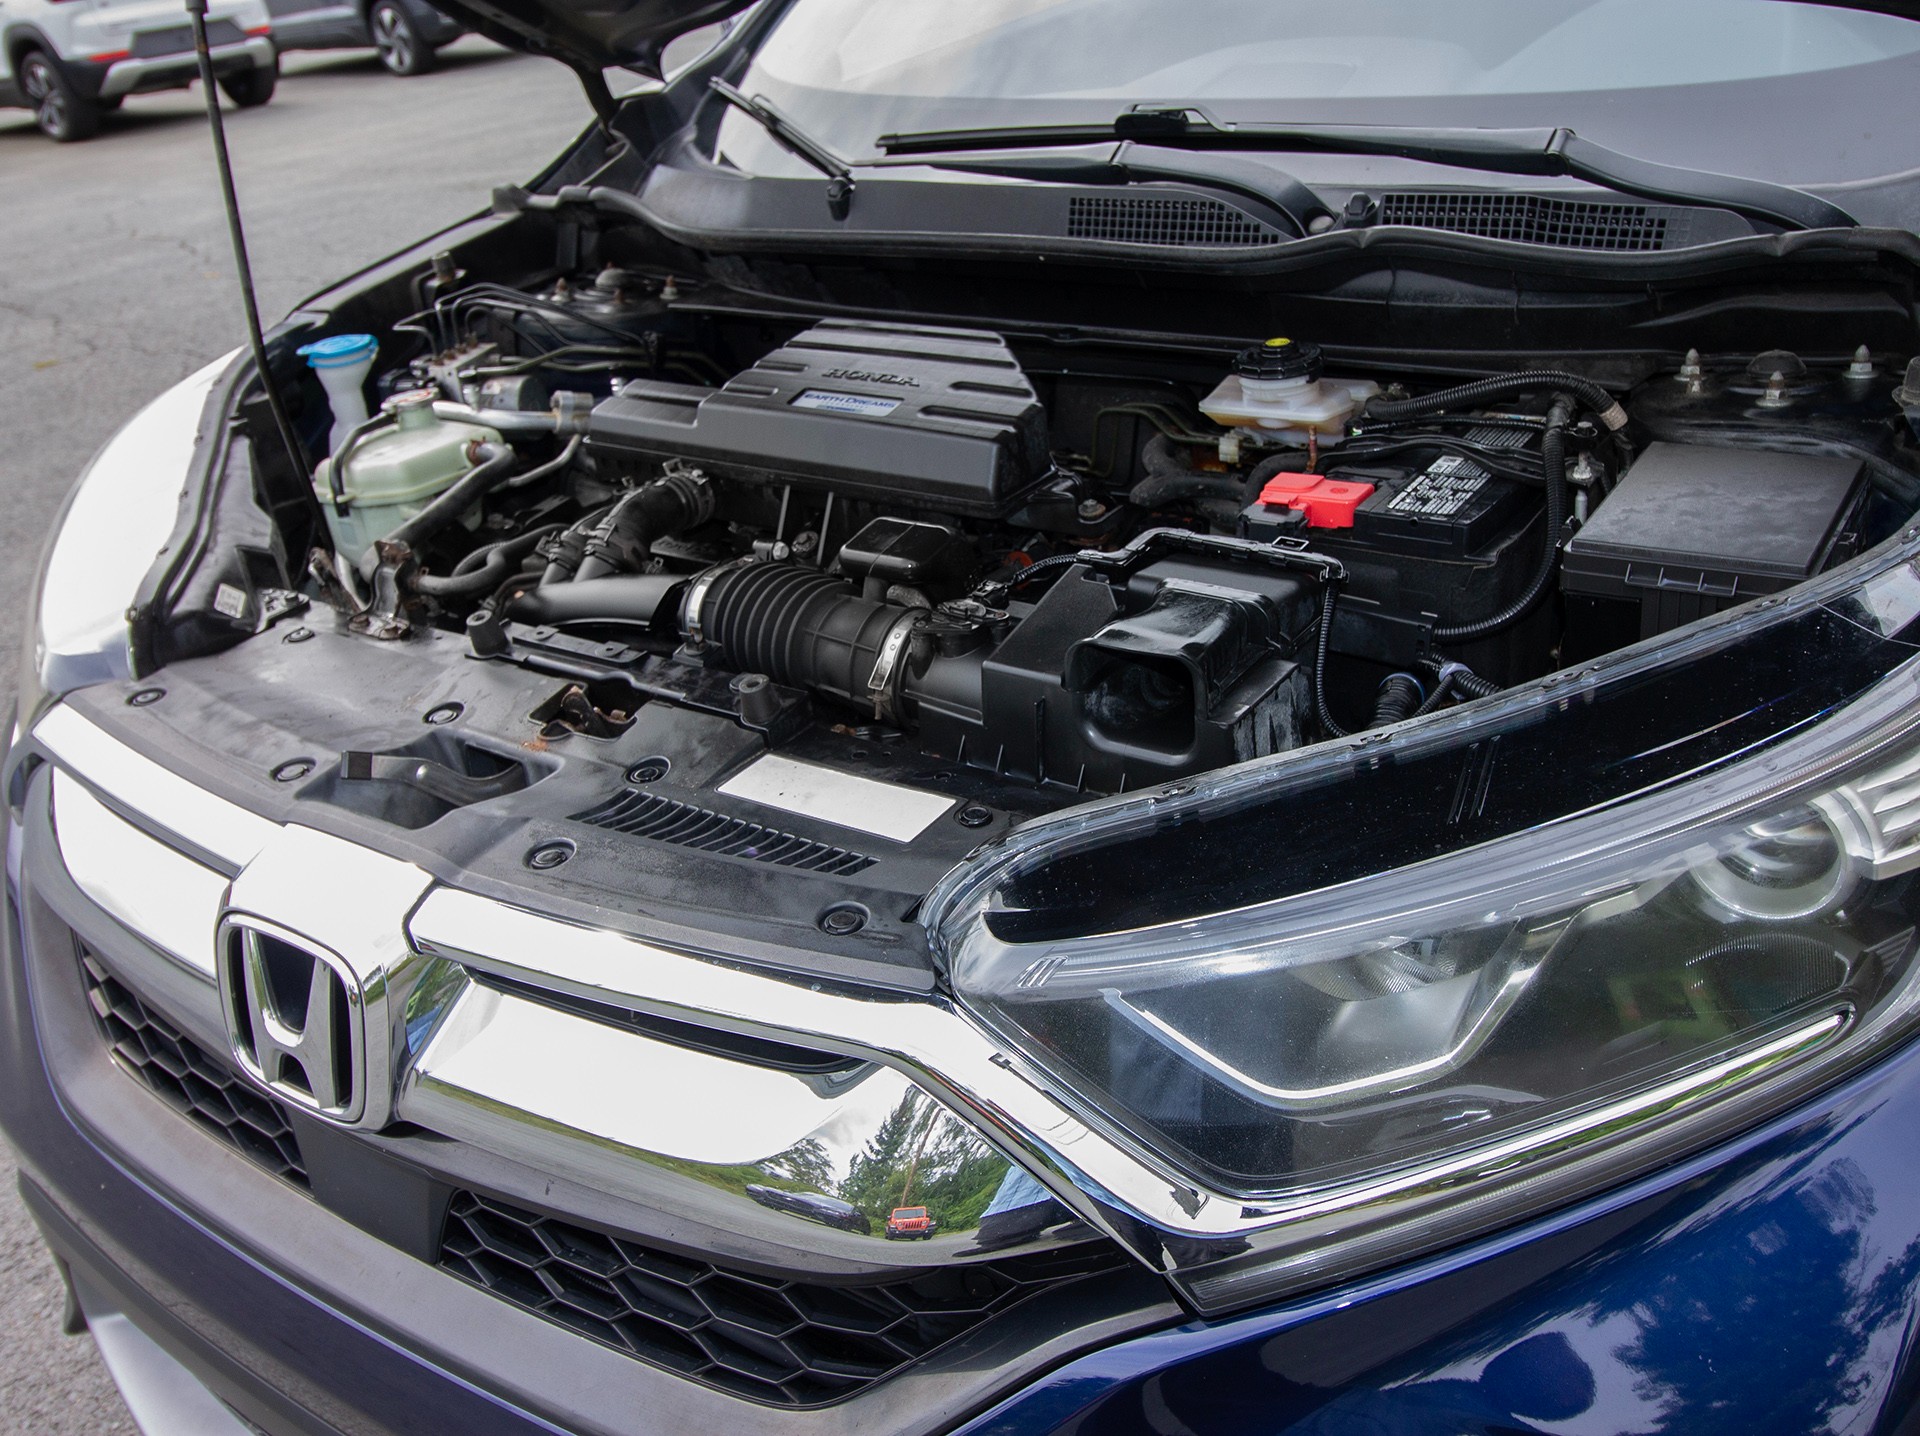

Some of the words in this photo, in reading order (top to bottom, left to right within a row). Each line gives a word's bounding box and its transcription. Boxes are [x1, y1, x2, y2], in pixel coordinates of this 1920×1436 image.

[822, 368, 920, 387] HONDA
[804, 394, 843, 402] EARTH
[845, 397, 896, 408] DREAMS
